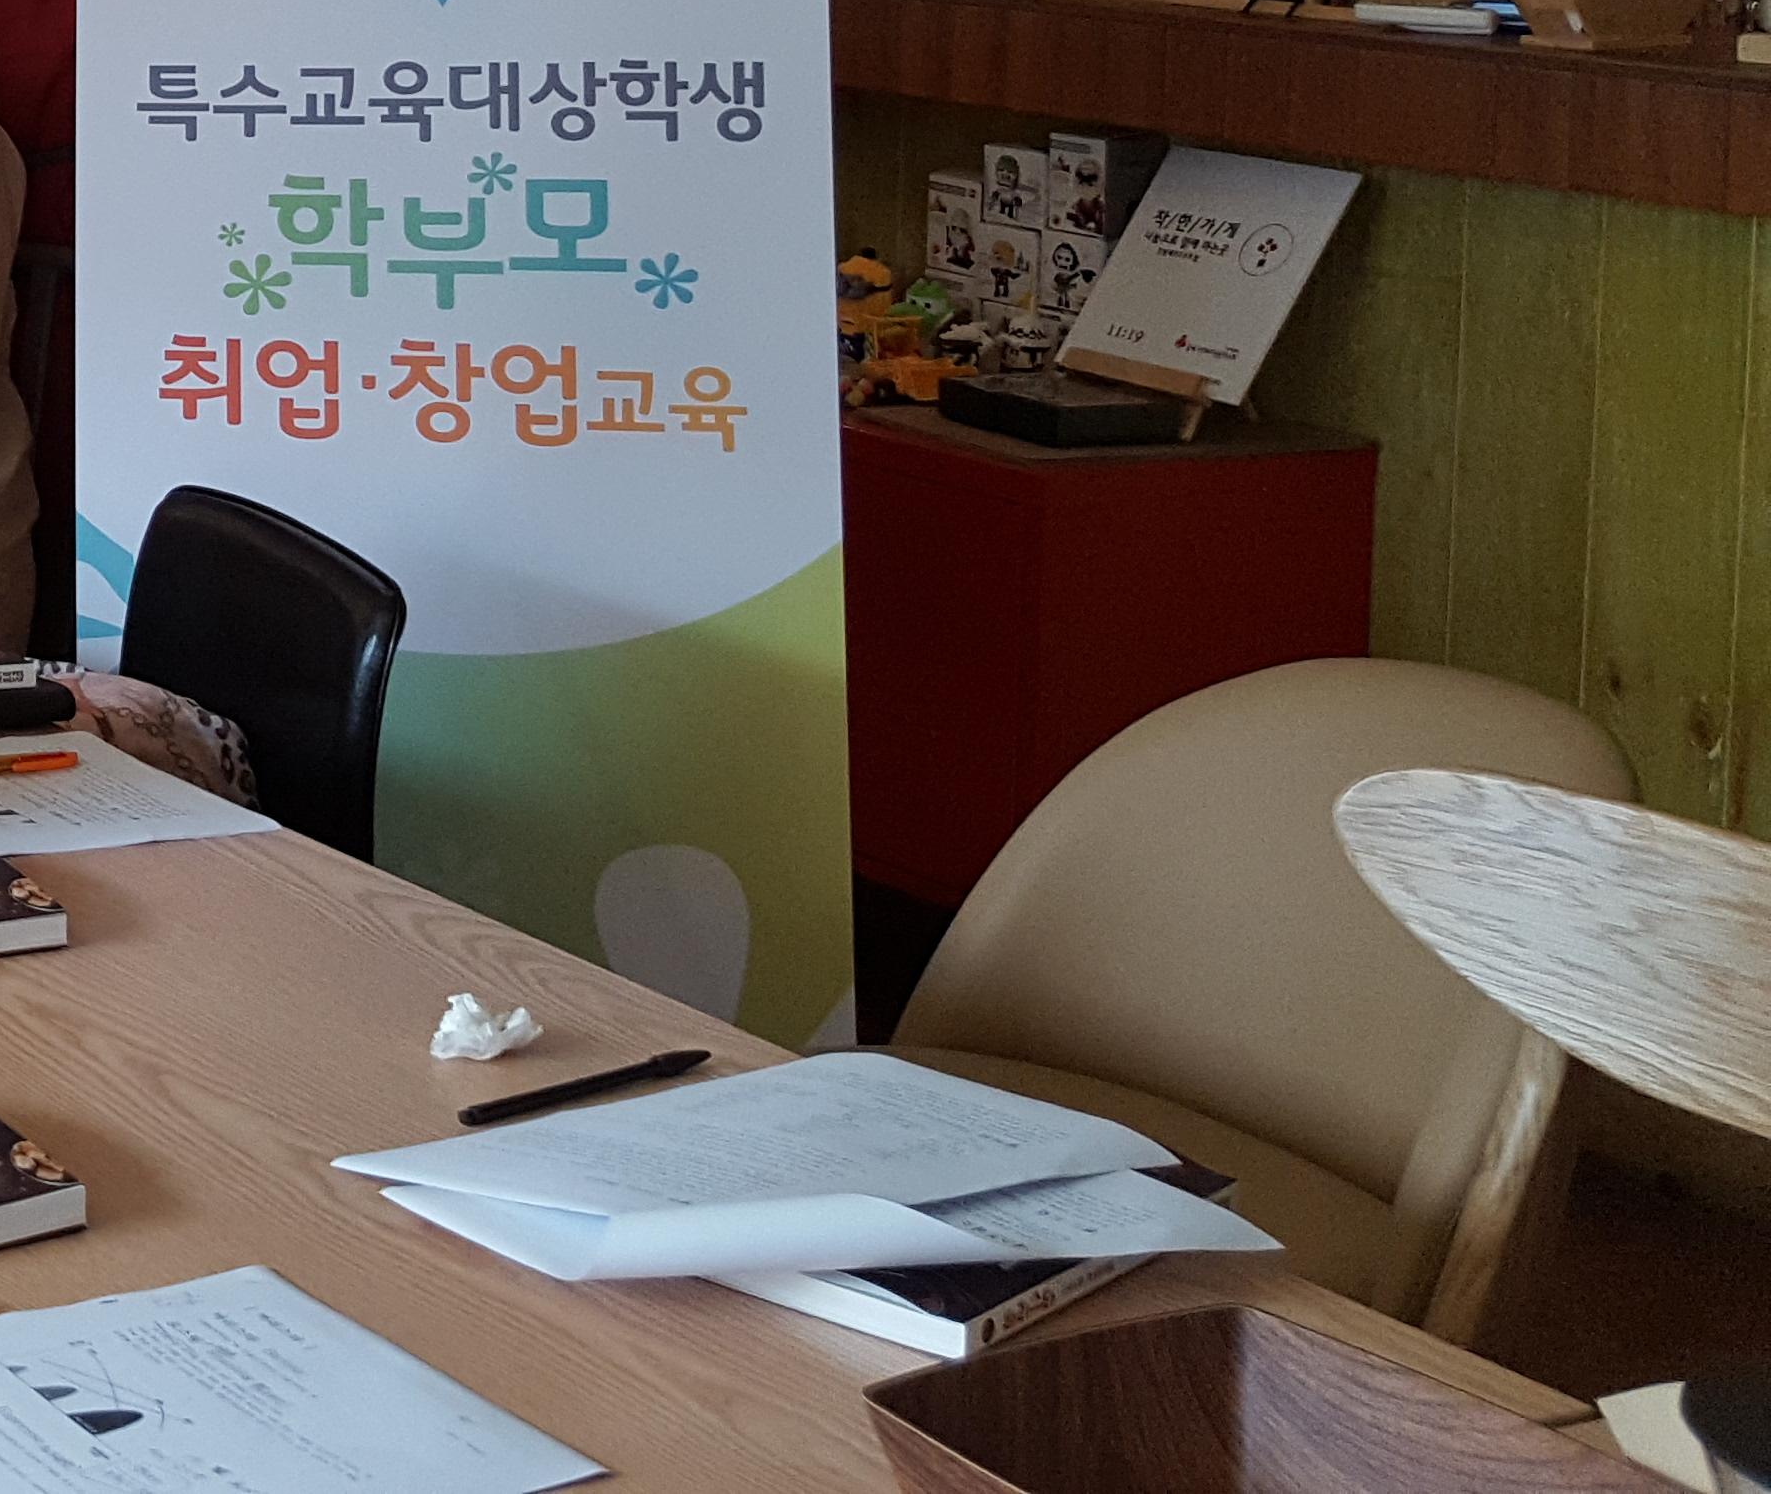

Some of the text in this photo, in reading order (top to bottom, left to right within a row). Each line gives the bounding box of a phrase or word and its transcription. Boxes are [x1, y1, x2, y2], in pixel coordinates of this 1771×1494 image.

[135, 58, 768, 143] 특수교육대상학생
[268, 173, 628, 311] 학부모
[1106, 323, 1146, 344] 11:19
[158, 332, 749, 453] 취업·창업교육
